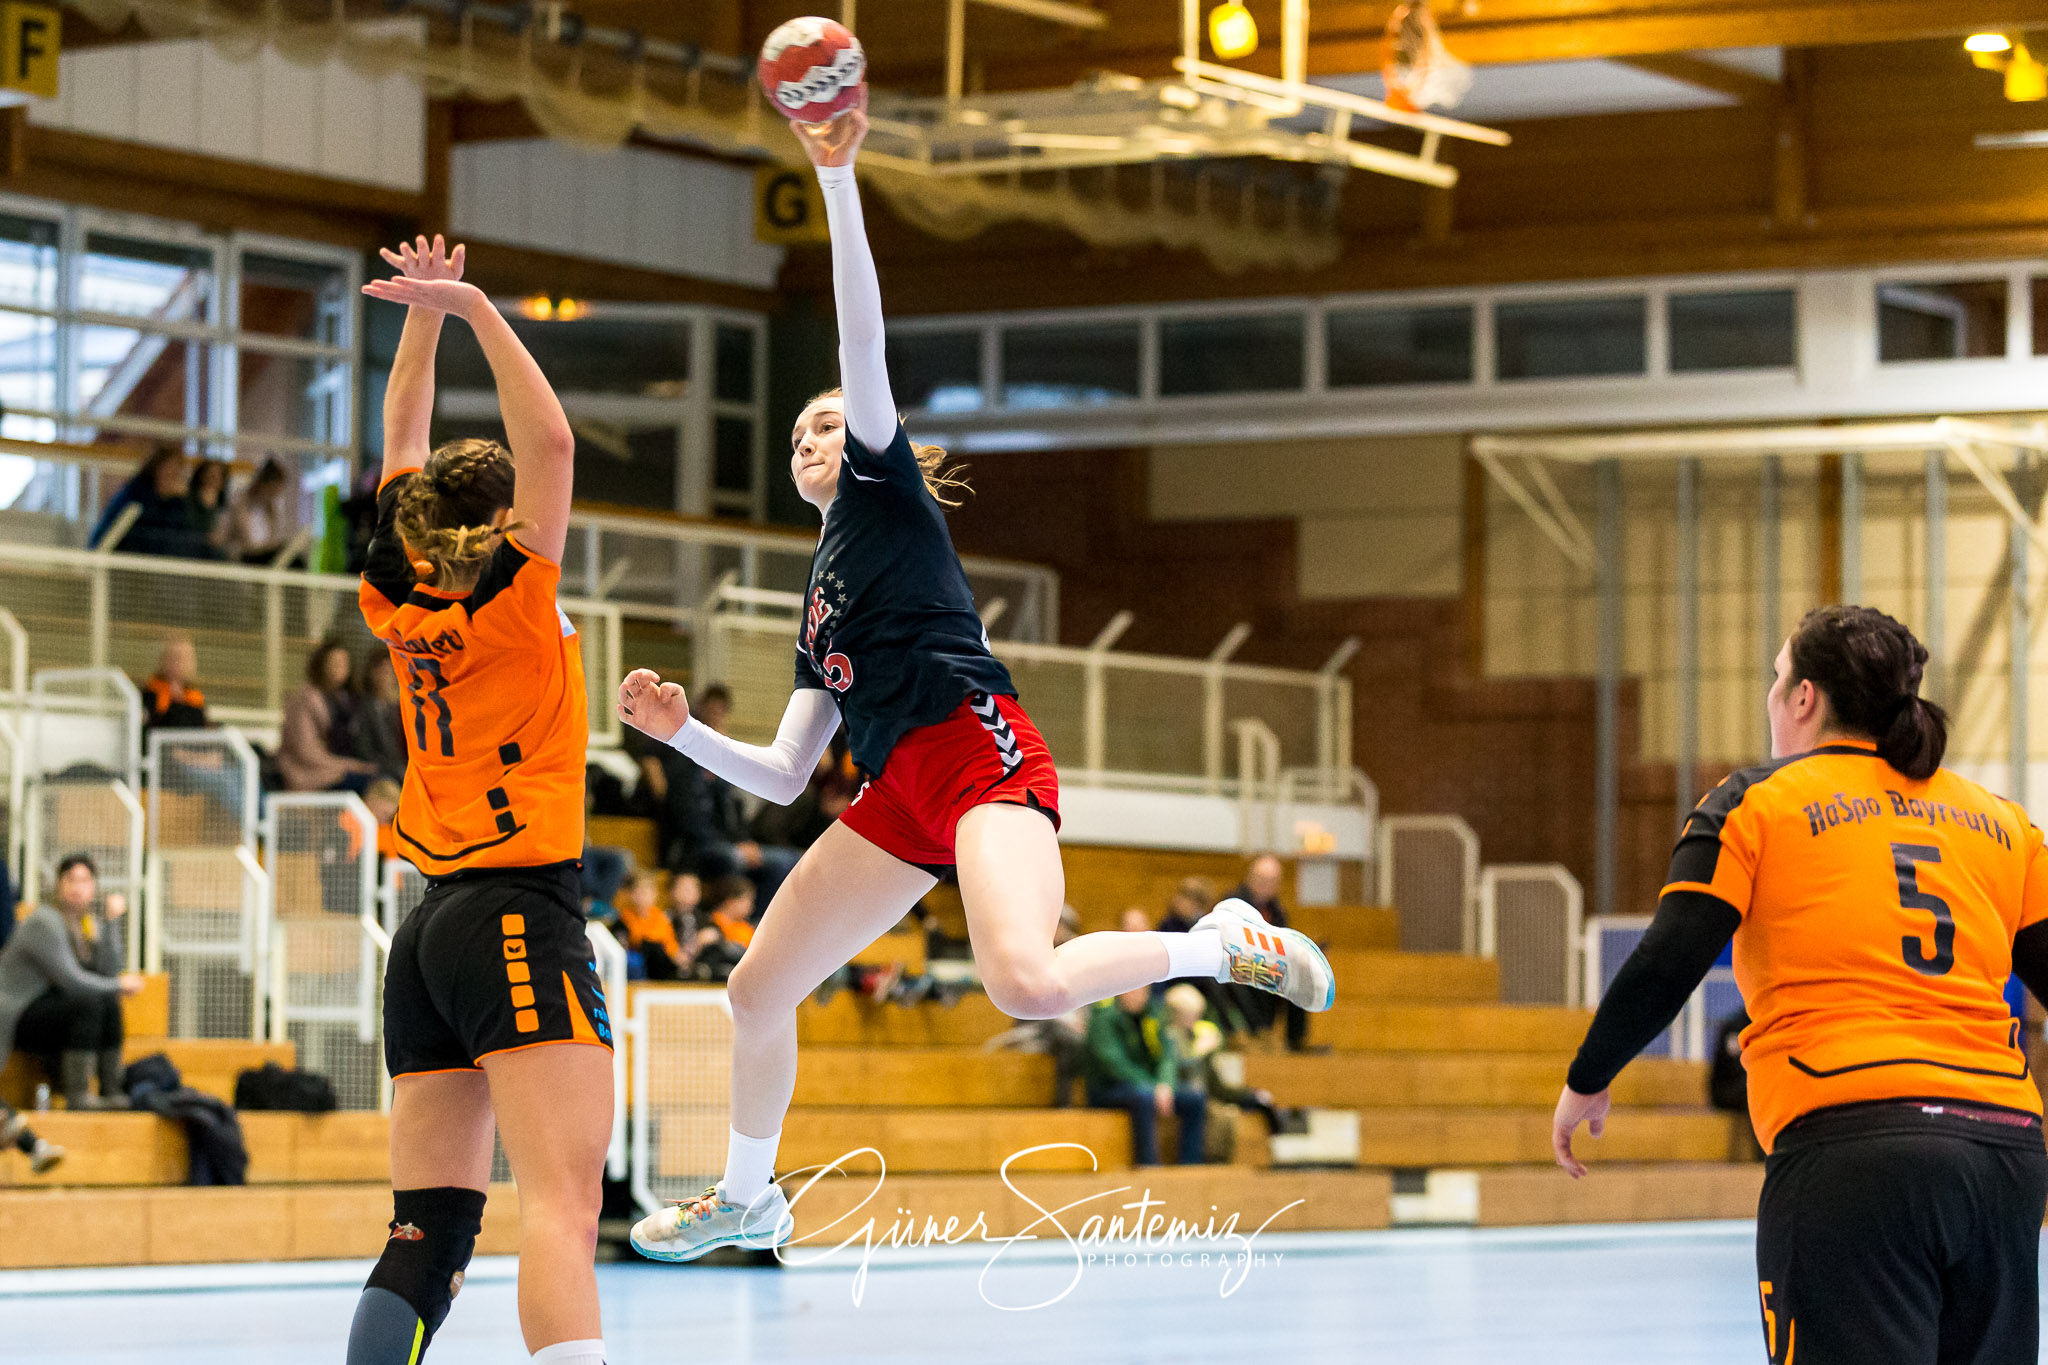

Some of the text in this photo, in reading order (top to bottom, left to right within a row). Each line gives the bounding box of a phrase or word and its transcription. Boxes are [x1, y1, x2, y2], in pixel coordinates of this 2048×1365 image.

[19, 20, 46, 79] F
[765, 172, 808, 229] G
[1803, 789, 2012, 851] HaSpo Bayreuth
[1890, 842, 1955, 977] 5
